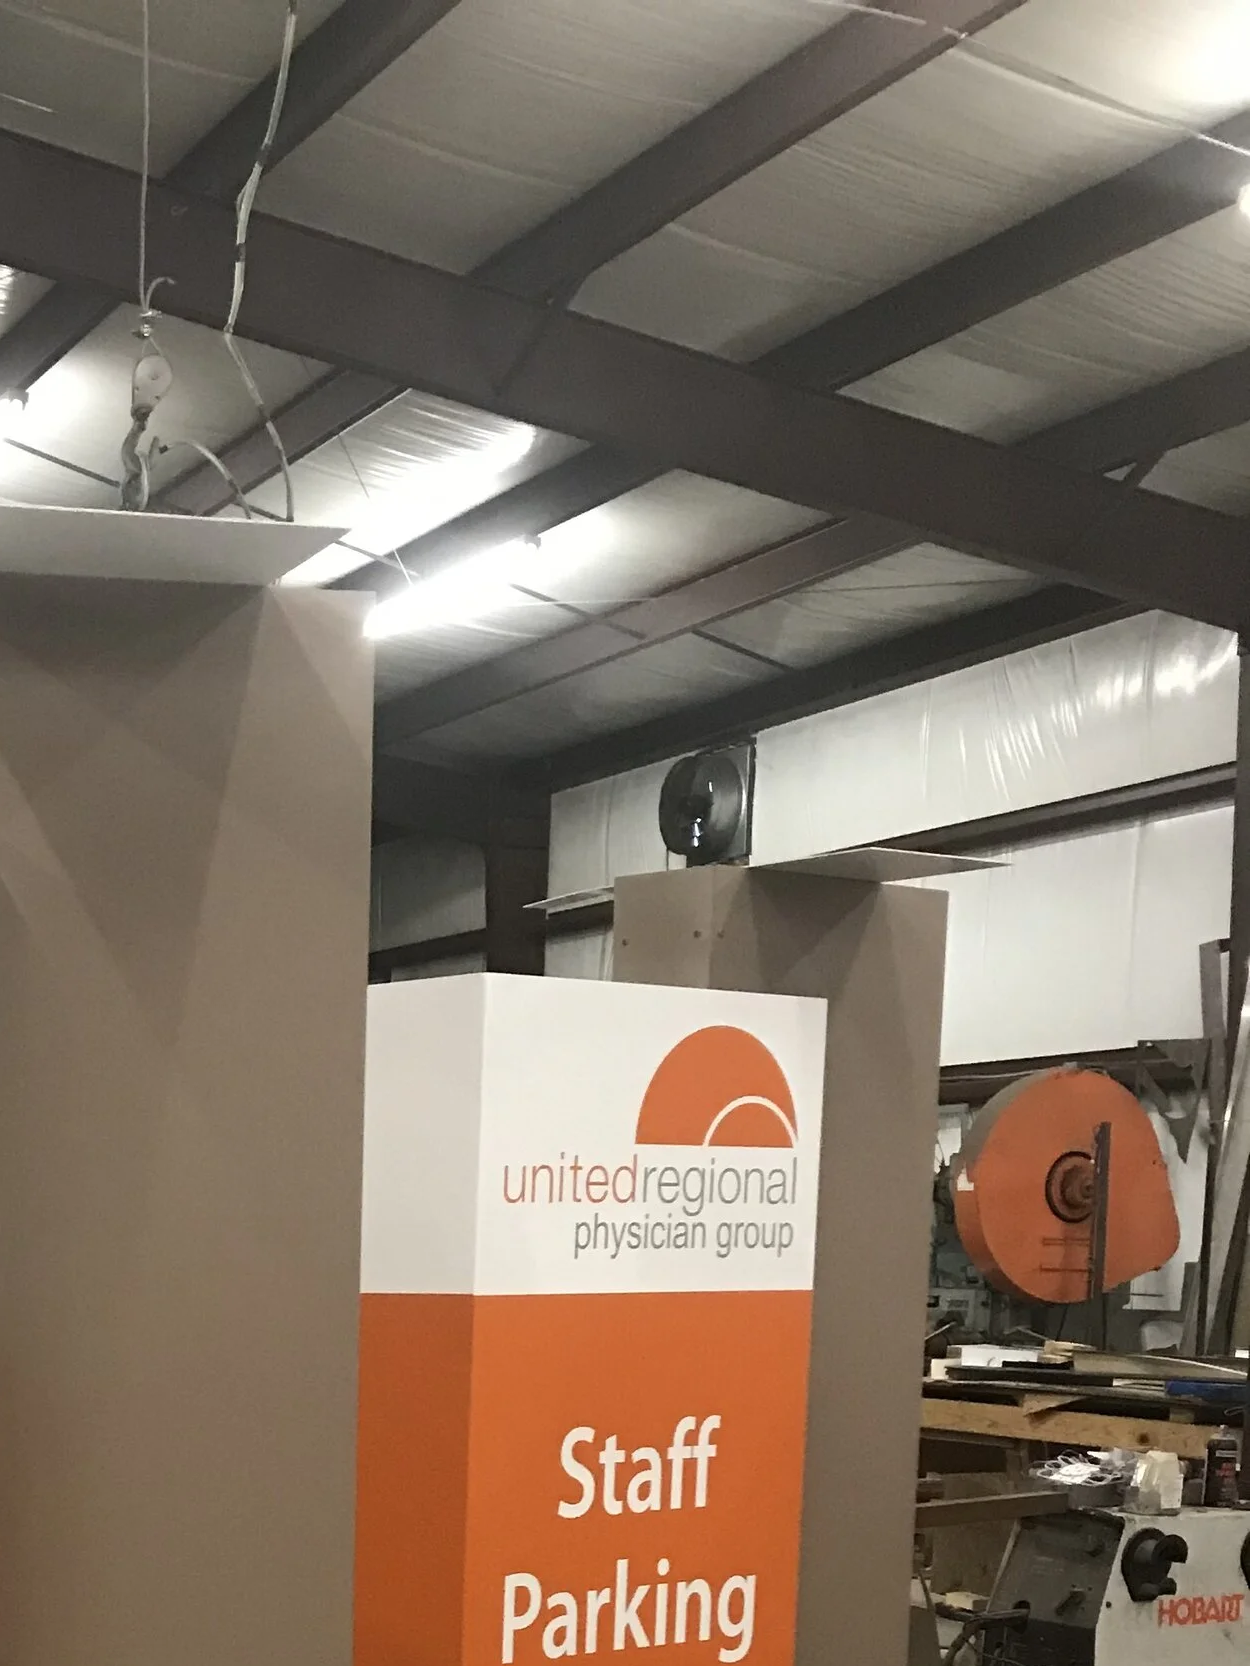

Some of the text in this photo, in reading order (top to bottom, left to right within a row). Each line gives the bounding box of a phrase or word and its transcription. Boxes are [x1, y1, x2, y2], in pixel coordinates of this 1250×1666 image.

[573, 1212, 794, 1260] physician group
[558, 1415, 720, 1518] Staff
[502, 1559, 757, 1664] Parking
